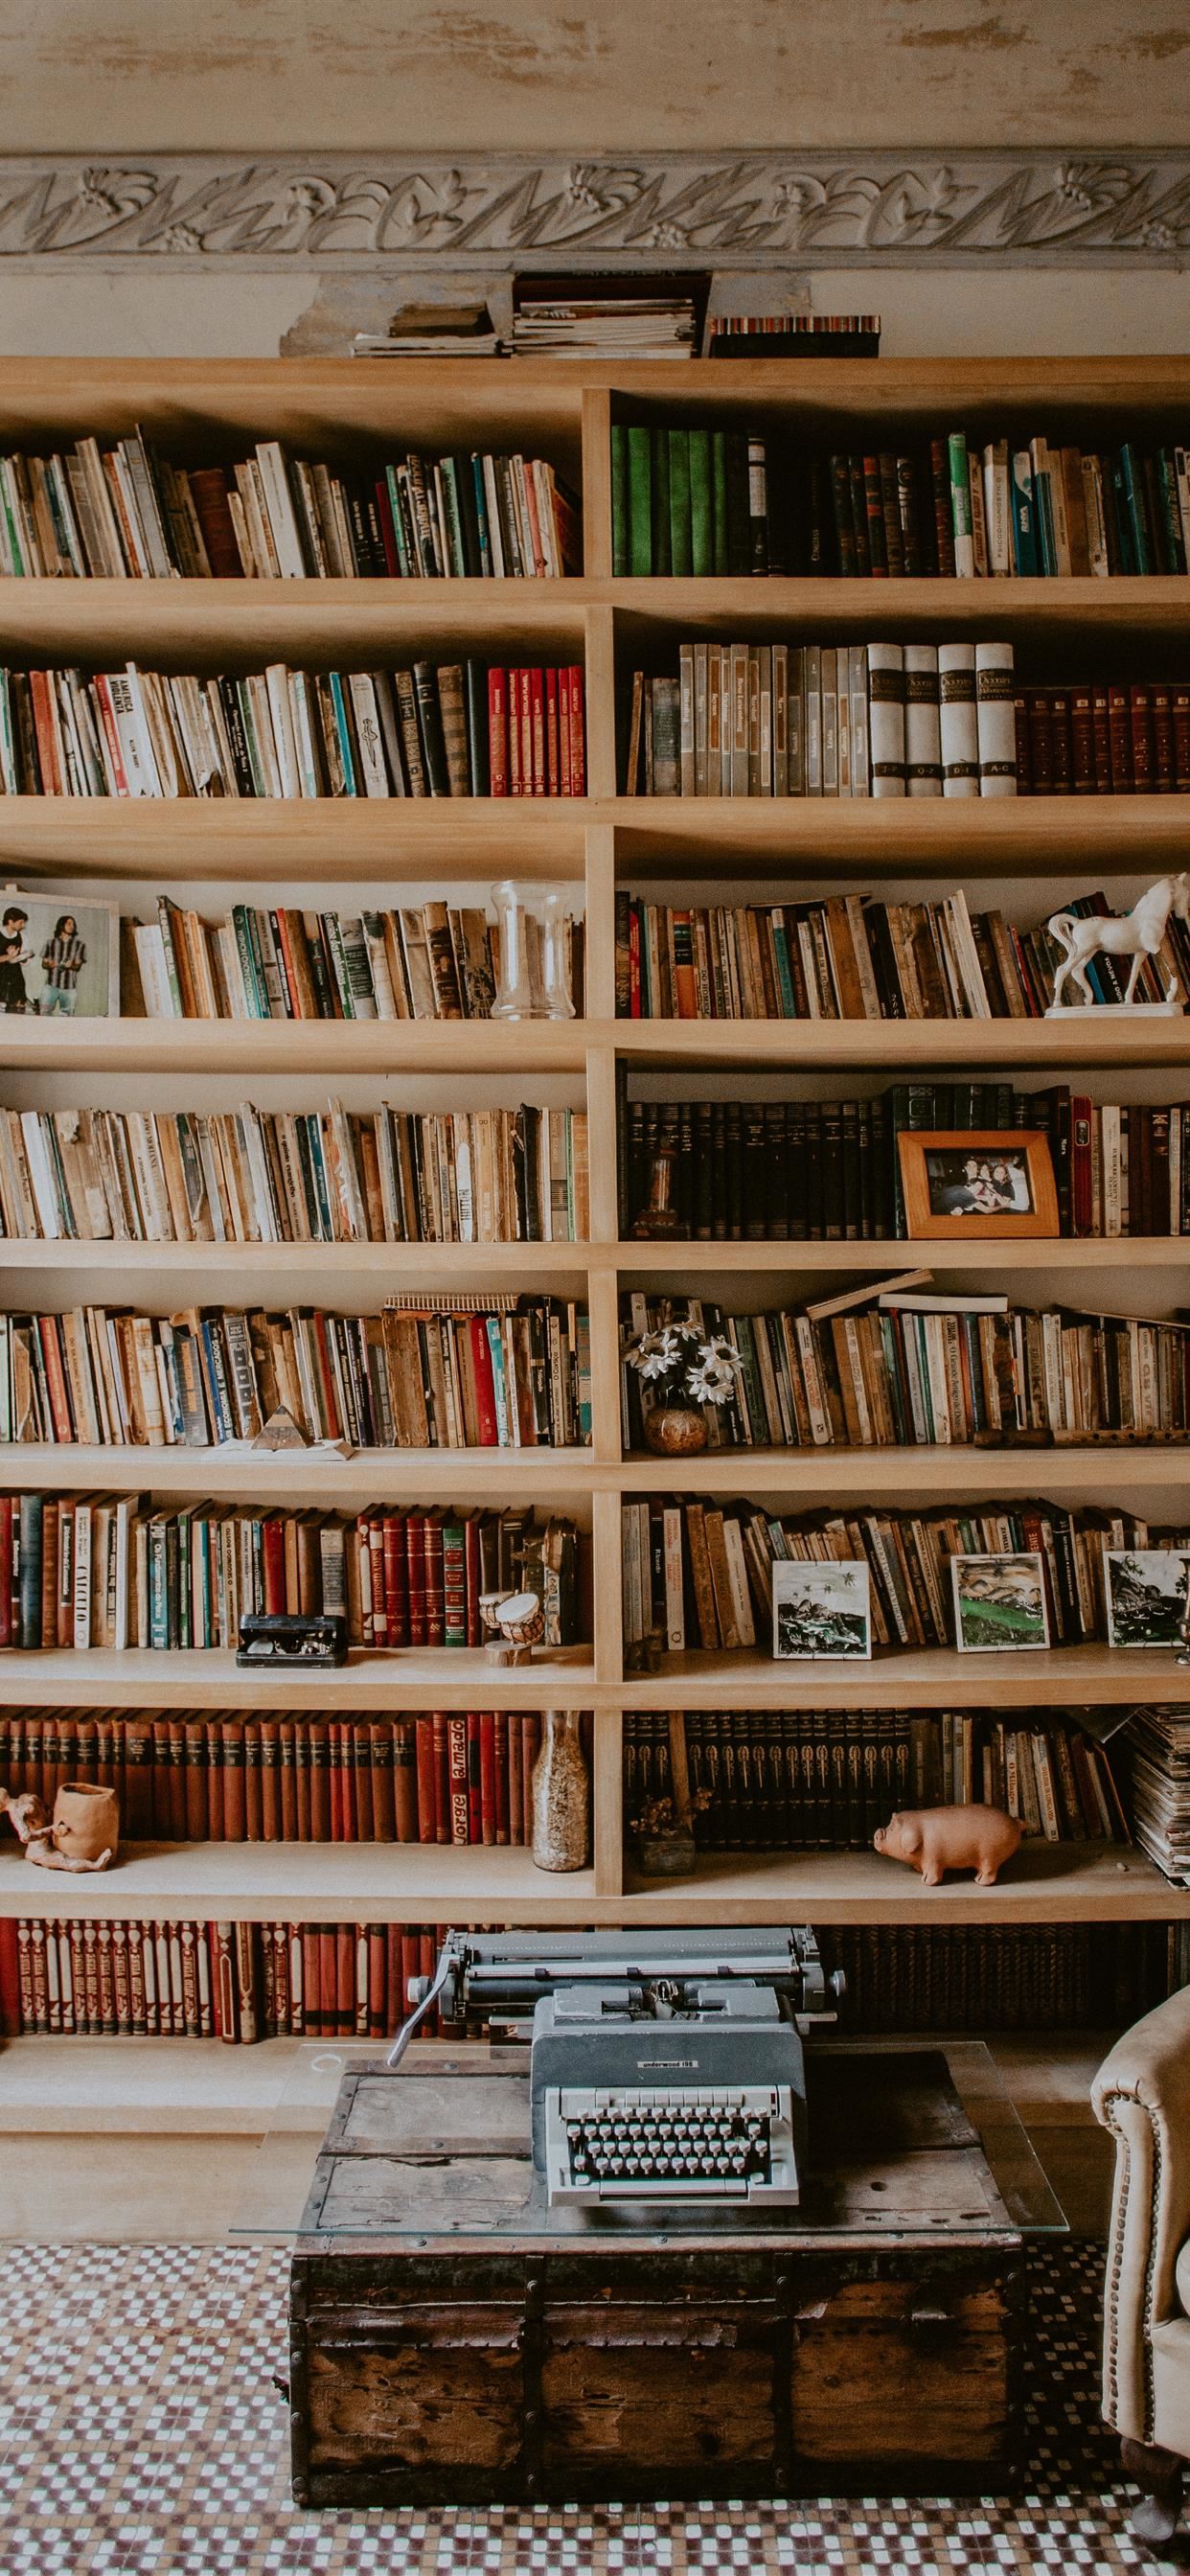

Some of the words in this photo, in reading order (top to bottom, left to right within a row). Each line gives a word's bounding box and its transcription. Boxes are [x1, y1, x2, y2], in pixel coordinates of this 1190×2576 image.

[110, 680, 126, 714] VIOLENTA
[214, 1340, 225, 1381] MERCADOS
[550, 1351, 561, 1374] Cortiço
[949, 1353, 959, 1372] Grande
[948, 1372, 961, 1393] Amigo
[220, 1391, 232, 1430] ECONOMIA
[223, 1528, 233, 1548] ROSTO
[154, 1554, 163, 1591] Fundamentos
[224, 1549, 234, 1578] SEGUNDO
[373, 1551, 384, 1613] CURIOSIDADES
[451, 1719, 467, 1778] amado
[1008, 1770, 1018, 1805] Milagre
[450, 1794, 468, 1844] Jorge
